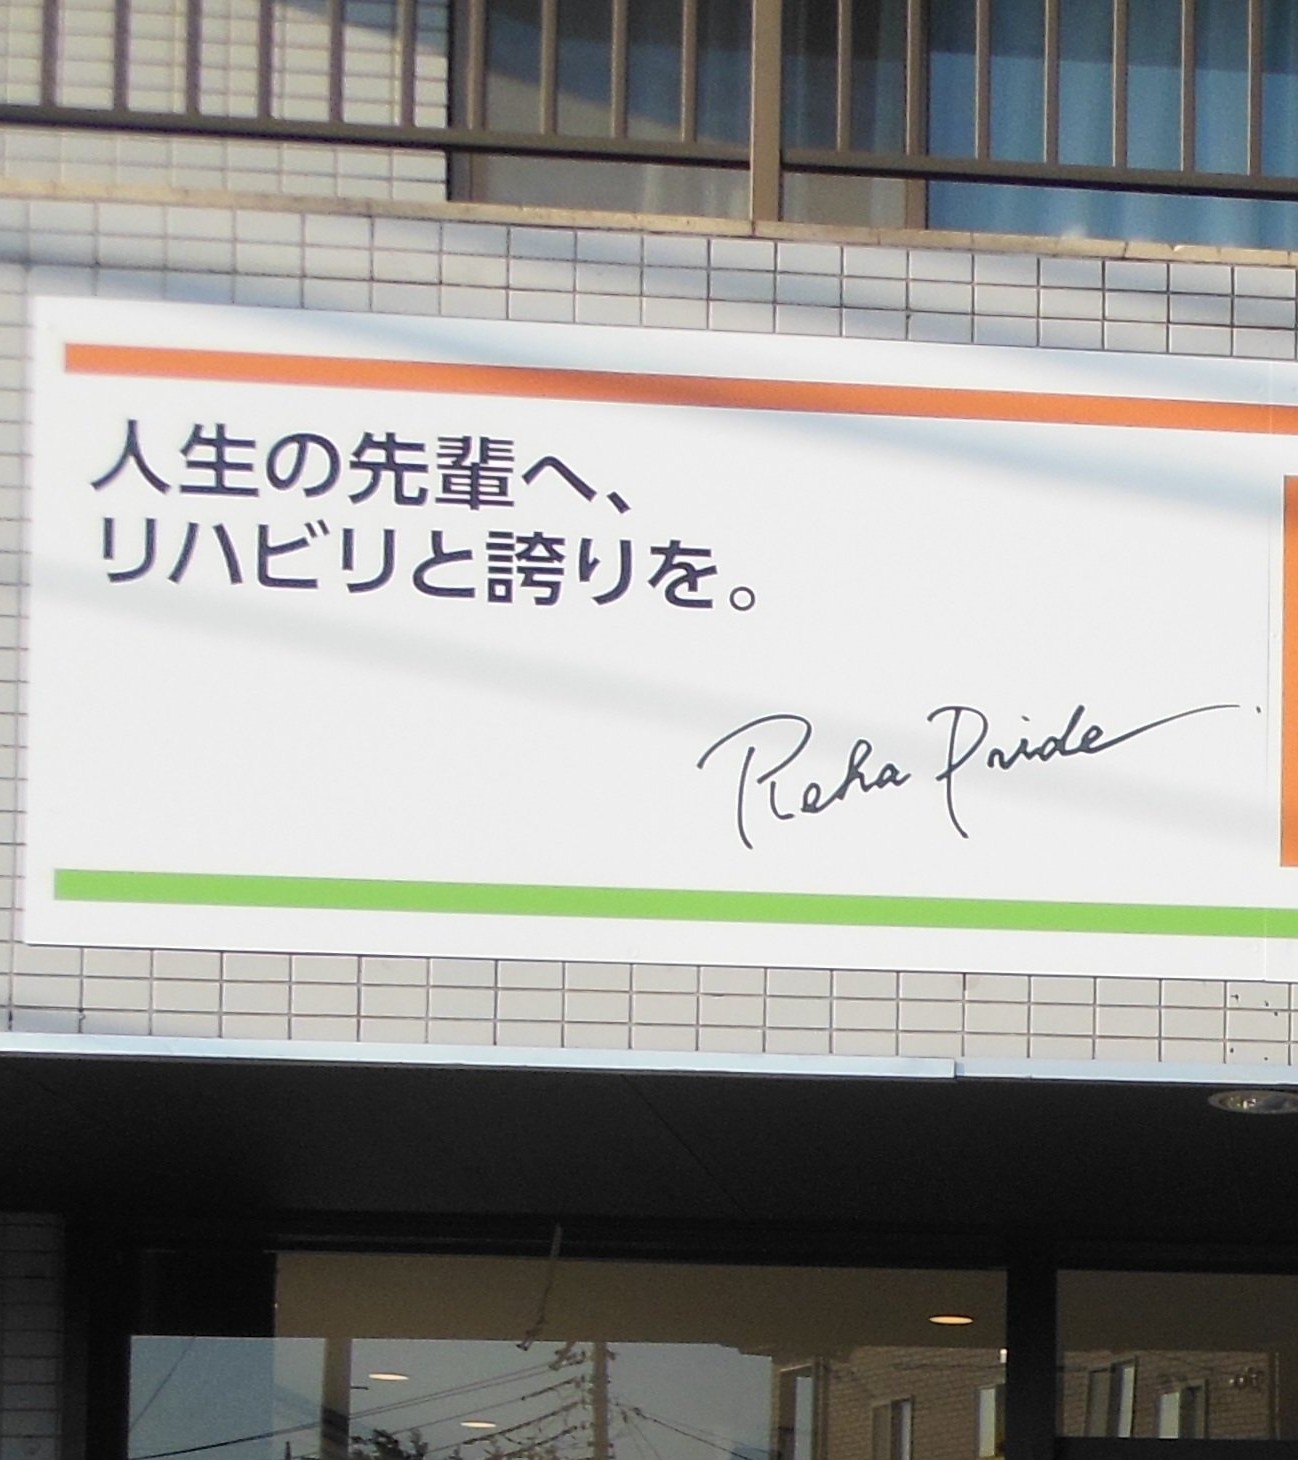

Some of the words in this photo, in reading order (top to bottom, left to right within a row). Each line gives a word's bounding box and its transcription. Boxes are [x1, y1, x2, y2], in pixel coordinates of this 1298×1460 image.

[89, 418, 634, 514] 人生の先輩へ、
[99, 516, 758, 613] リハビリと誇りを。
[697, 713, 911, 850] Reha
[927, 703, 1242, 840] Pride
